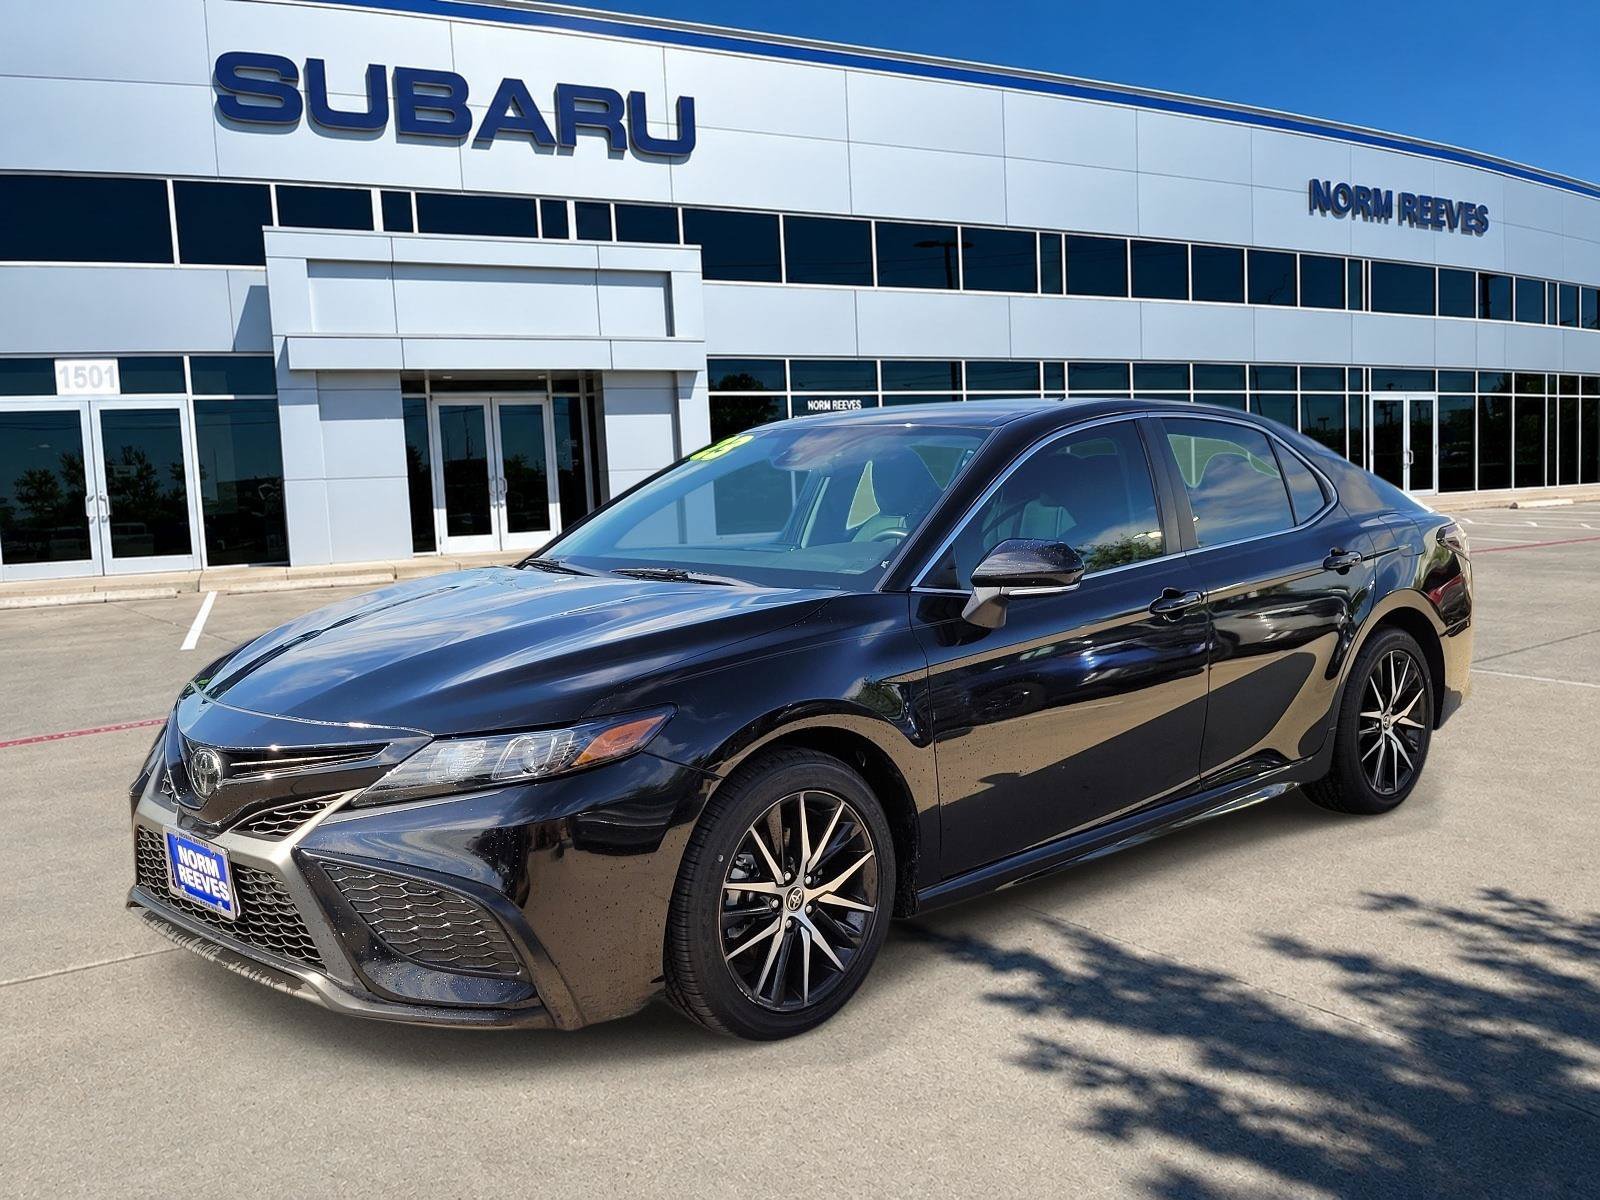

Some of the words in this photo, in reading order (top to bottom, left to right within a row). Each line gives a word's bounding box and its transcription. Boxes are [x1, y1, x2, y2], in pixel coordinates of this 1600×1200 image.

[213, 50, 697, 159] SUBARU
[1309, 178, 1393, 223] NORM
[1398, 191, 1489, 236] REEVES
[59, 365, 115, 389] 1501
[807, 400, 831, 411] NORM
[832, 399, 862, 410] REEVES
[177, 844, 220, 879] NORM
[177, 863, 230, 901] REEVES
